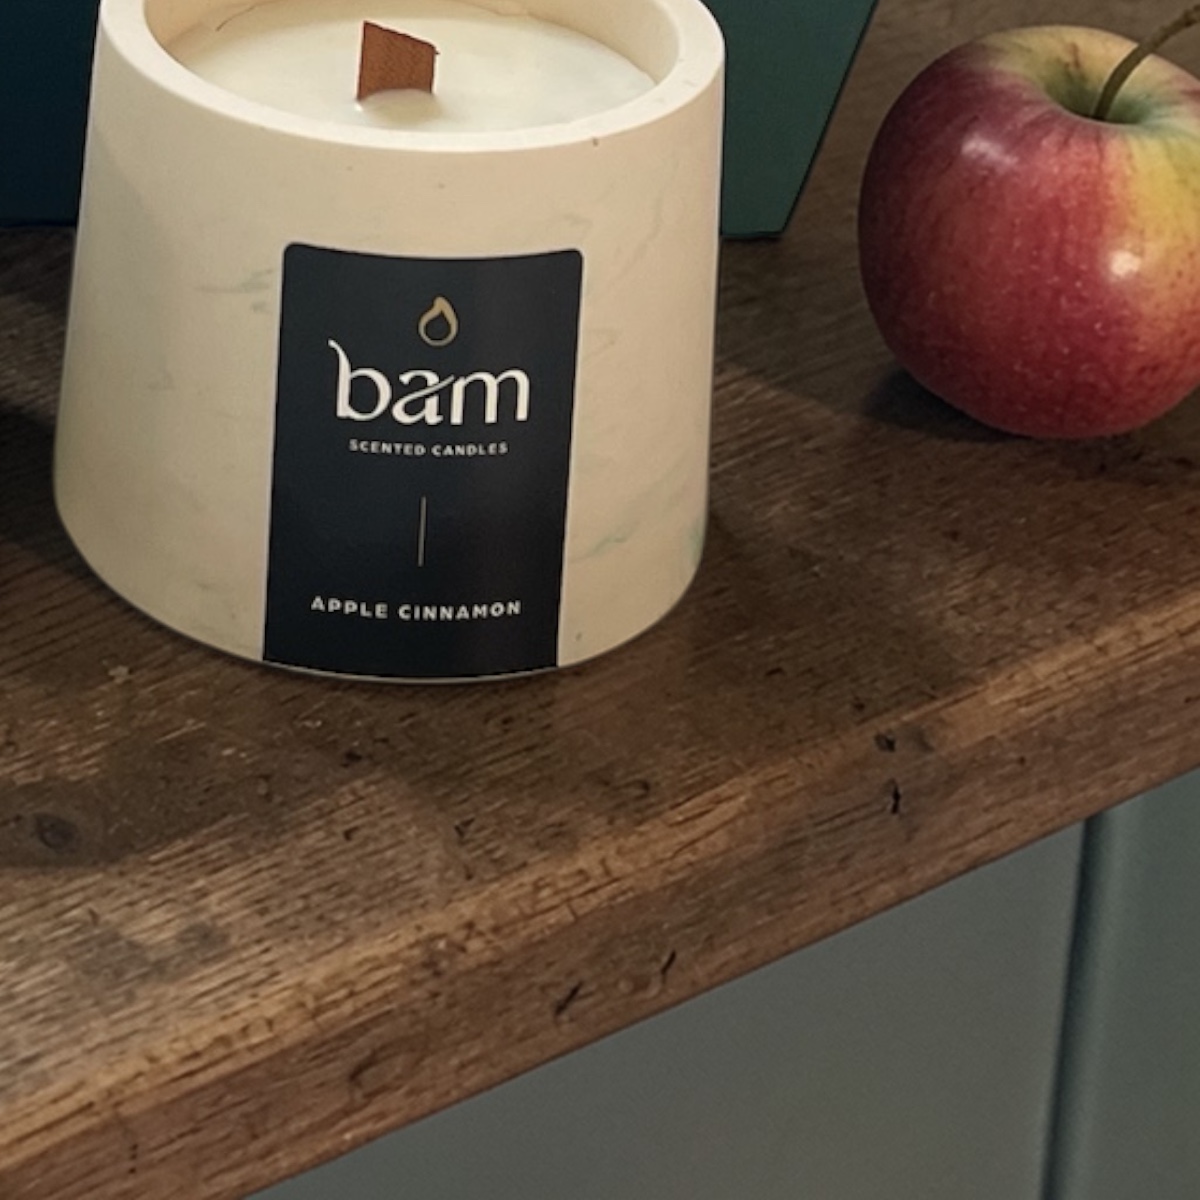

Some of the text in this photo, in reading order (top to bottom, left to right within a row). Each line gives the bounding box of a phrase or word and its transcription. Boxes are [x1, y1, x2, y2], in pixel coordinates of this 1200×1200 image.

[327, 339, 531, 426] bam
[349, 438, 509, 457] SCENTED CANDLES
[310, 595, 522, 621] APPLE CINNAMON
